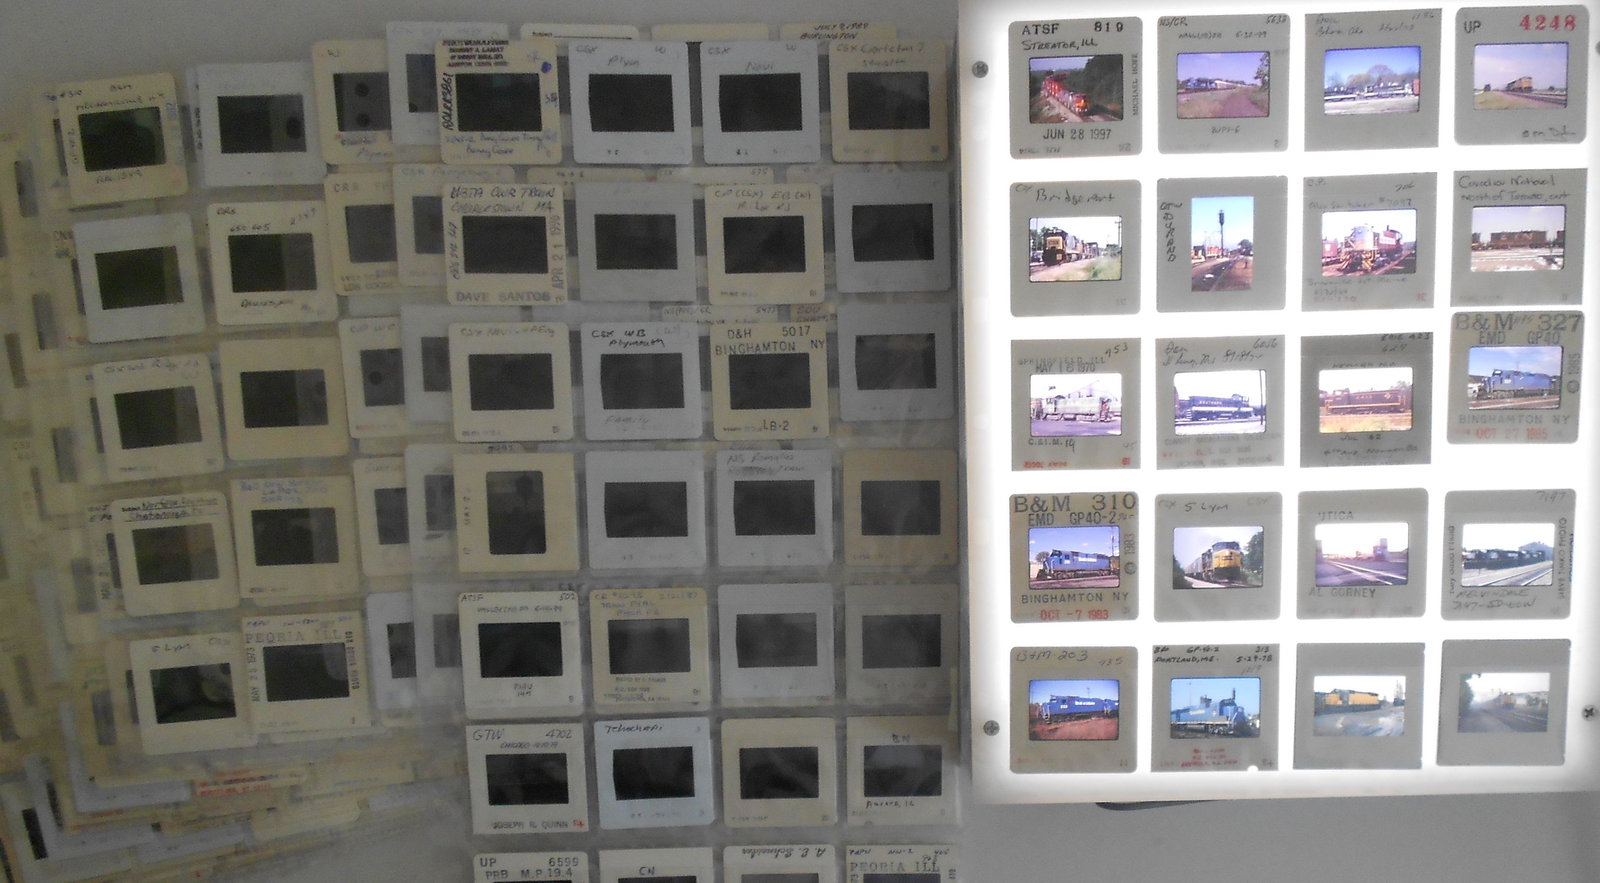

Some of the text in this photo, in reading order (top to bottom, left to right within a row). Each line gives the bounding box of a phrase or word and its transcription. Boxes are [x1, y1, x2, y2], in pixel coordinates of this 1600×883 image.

[1464, 20, 1481, 34] UP
[1519, 14, 1577, 31] 4248
[1022, 23, 1059, 36] ATSF
[1043, 128, 1112, 141] JUN 28 1997
[1455, 314, 1513, 331] B&M
[1537, 313, 1583, 332] 327
[727, 329, 752, 340] D&H
[781, 325, 811, 337] 5017
[1479, 331, 1560, 345] EMD GP40
[714, 339, 826, 355] BINGHAMTON NY
[1457, 414, 1571, 425] BINGHAMTON NY
[1013, 493, 1137, 513] B&M 310
[1028, 513, 1055, 526] EMD
[1069, 511, 1117, 526] GP40-2
[1317, 510, 1355, 522] UTICA
[1124, 533, 1136, 556] 1983
[1021, 591, 1130, 604] BINGHAMTON NY
[1308, 587, 1376, 598] AL GORNEY
[1040, 608, 1060, 621] OCT
[1087, 608, 1109, 620] 1983
[245, 628, 342, 644] PEORIA ILL
[472, 728, 505, 741] GTW
[541, 820, 569, 829] QUINN
[480, 857, 497, 867] UP
[548, 857, 579, 867] 6599
[850, 860, 940, 872] PEORIA ILL
